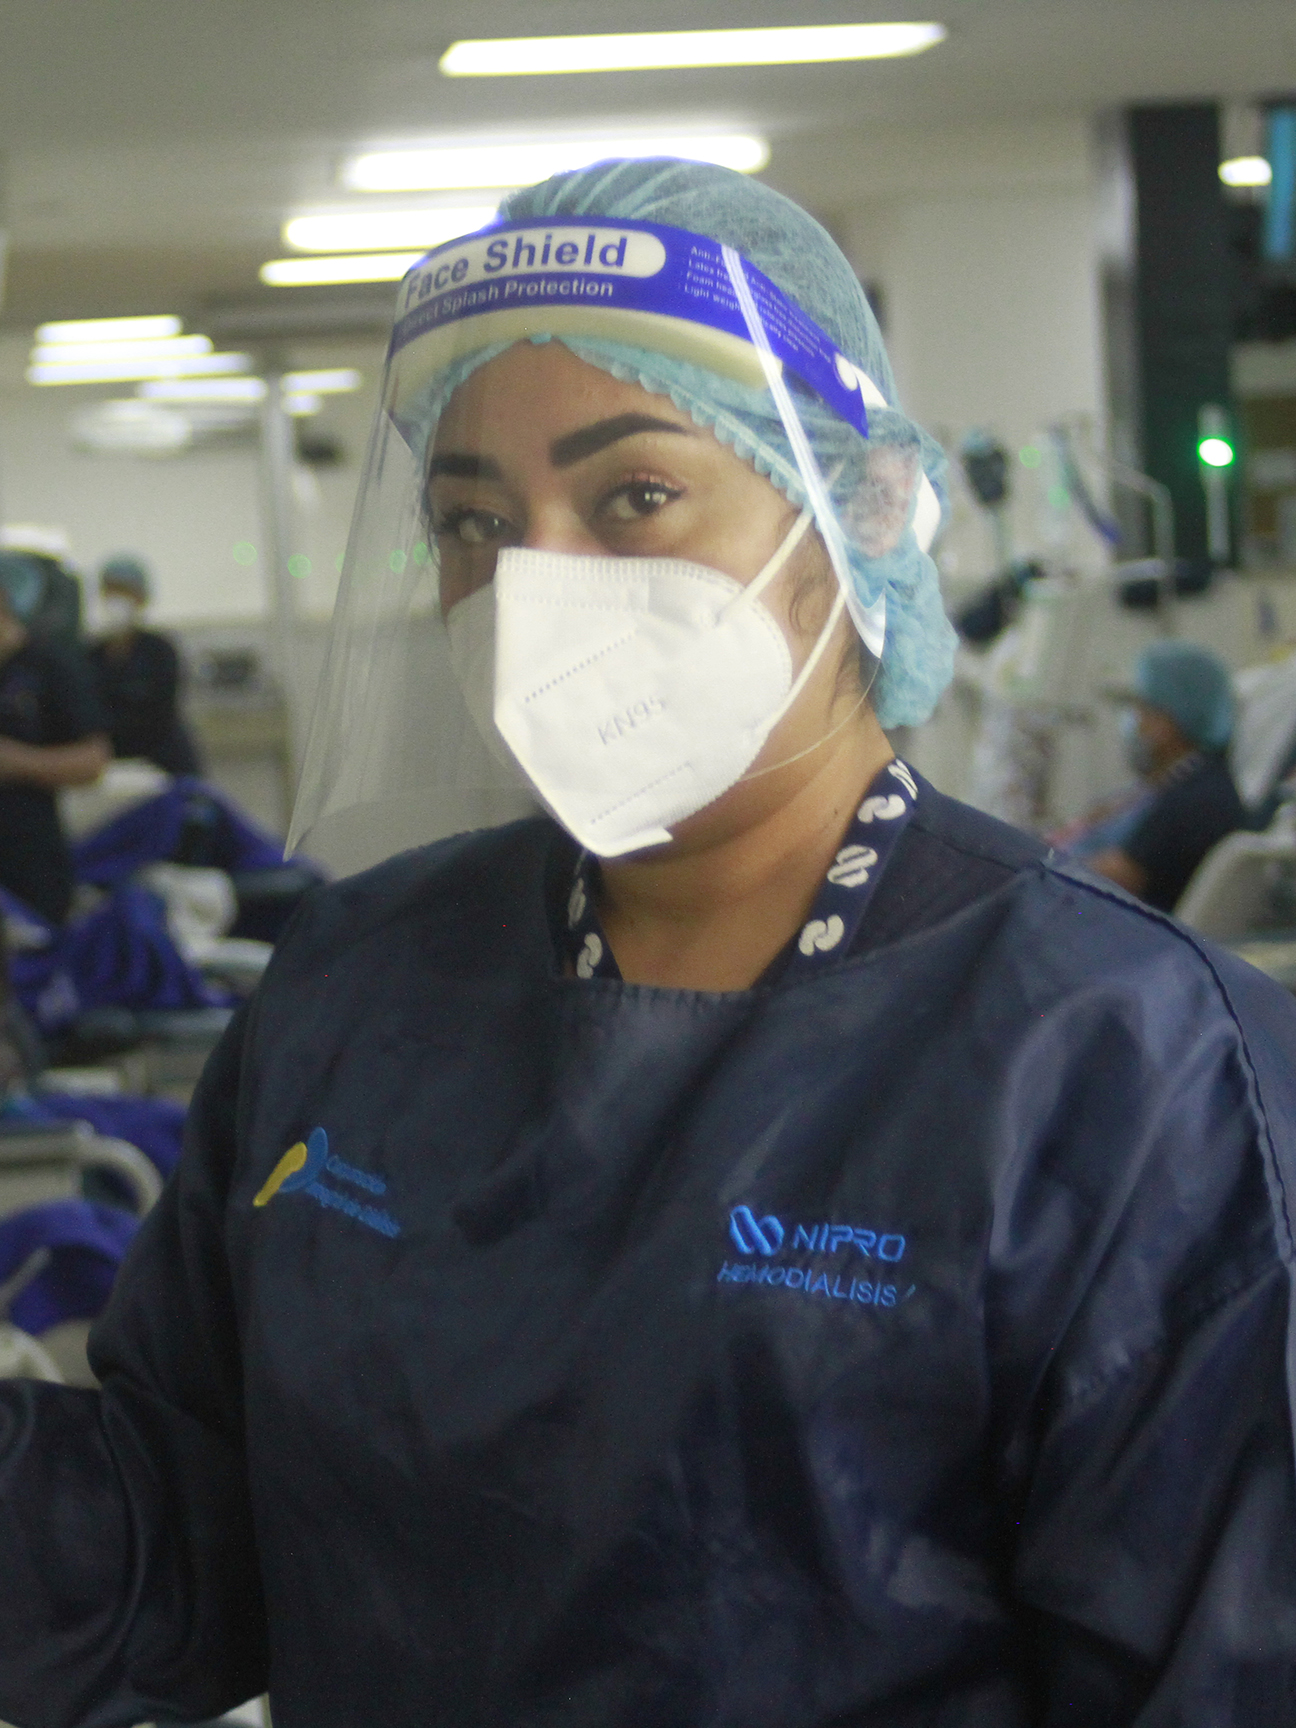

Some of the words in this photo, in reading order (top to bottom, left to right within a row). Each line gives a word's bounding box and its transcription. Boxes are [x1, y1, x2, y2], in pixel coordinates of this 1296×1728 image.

[404, 256, 469, 309] Face
[483, 233, 628, 273] Shield
[443, 284, 500, 316] Splash
[504, 278, 614, 298] Protection
[684, 284, 710, 300] Light
[596, 697, 667, 746] KN95
[792, 1223, 907, 1263] NIPRO
